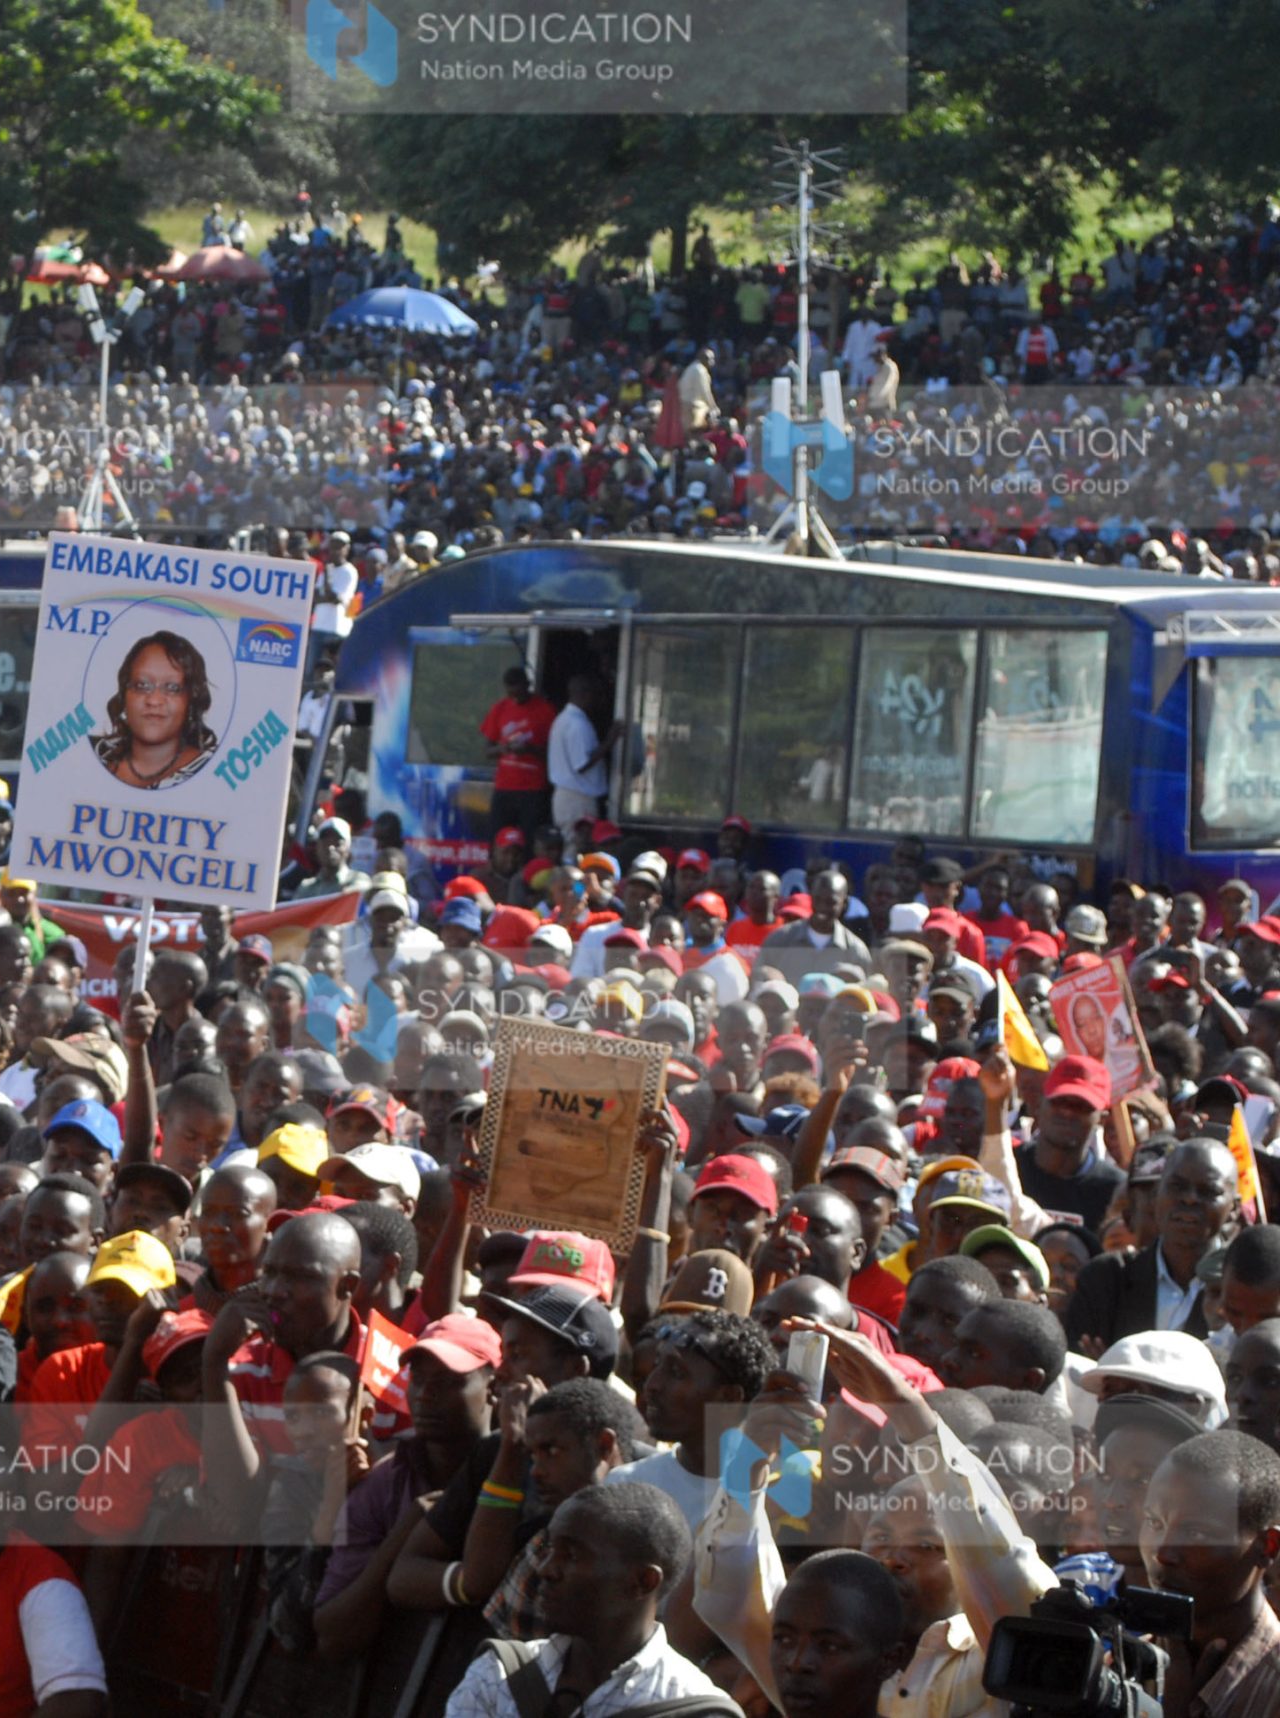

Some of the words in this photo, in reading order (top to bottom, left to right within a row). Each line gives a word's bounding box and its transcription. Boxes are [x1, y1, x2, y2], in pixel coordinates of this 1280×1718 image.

[50, 541, 200, 586] EMBAKASI
[210, 562, 309, 600] SOUTH
[45, 604, 111, 636] M.P.
[250, 639, 292, 657] NARC
[26, 702, 96, 774] MAMA
[214, 710, 289, 790] TOSHA
[70, 804, 227, 850] PURITY
[26, 836, 259, 893] MWONGELI
[538, 1088, 580, 1114] TNA
[702, 1267, 728, 1298] B
